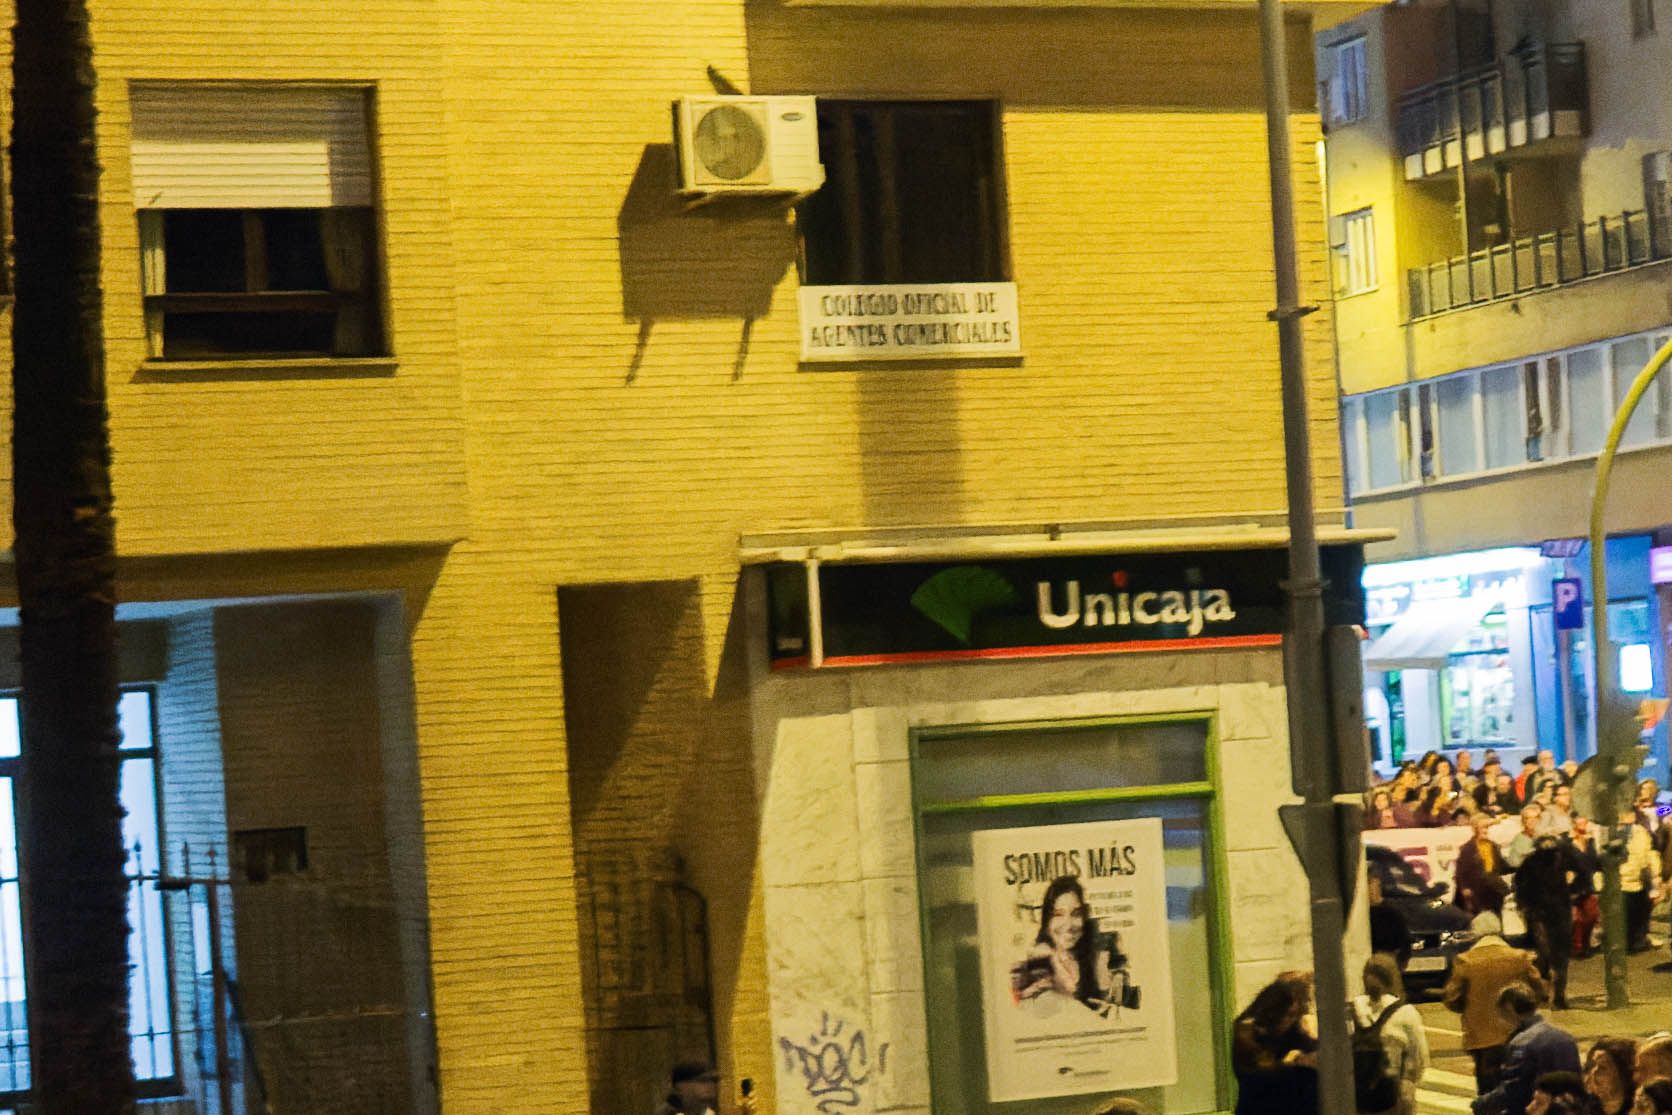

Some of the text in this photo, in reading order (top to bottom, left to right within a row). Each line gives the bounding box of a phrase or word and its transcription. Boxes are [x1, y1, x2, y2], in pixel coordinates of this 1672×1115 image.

[811, 320, 1012, 347] AGENTES COMERCIALES
[1037, 569, 1236, 637] Unicaja
[1003, 840, 1137, 885] SOMOS MÁS
